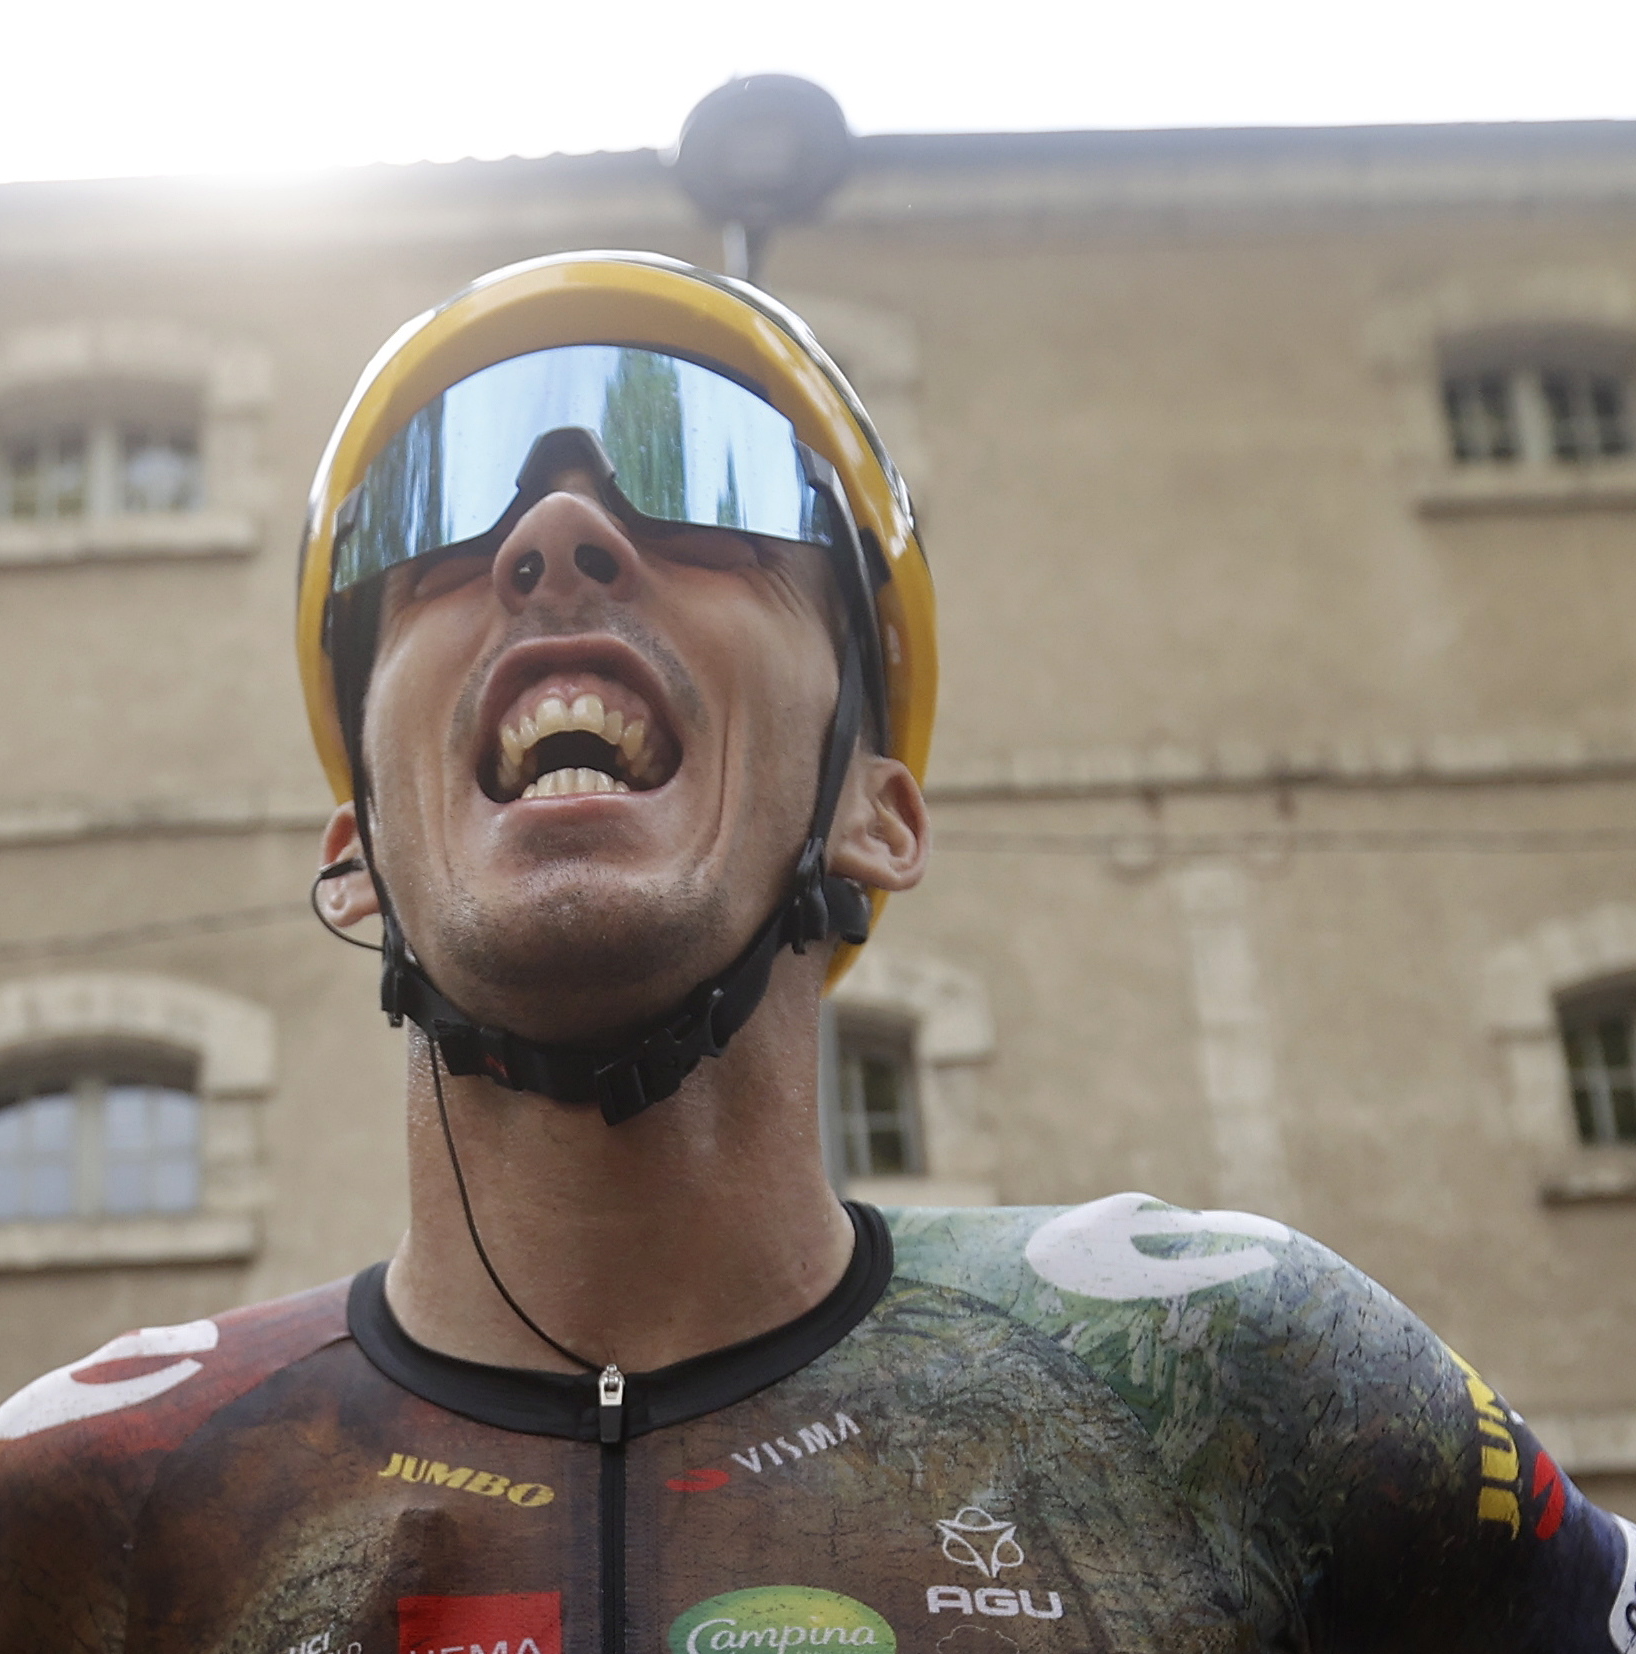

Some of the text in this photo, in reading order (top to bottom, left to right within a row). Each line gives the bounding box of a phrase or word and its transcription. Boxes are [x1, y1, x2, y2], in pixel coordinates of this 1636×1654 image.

[730, 1411, 862, 1474] VISMA
[377, 1452, 555, 1507] JUMBO
[925, 1585, 1063, 1620] AGU
